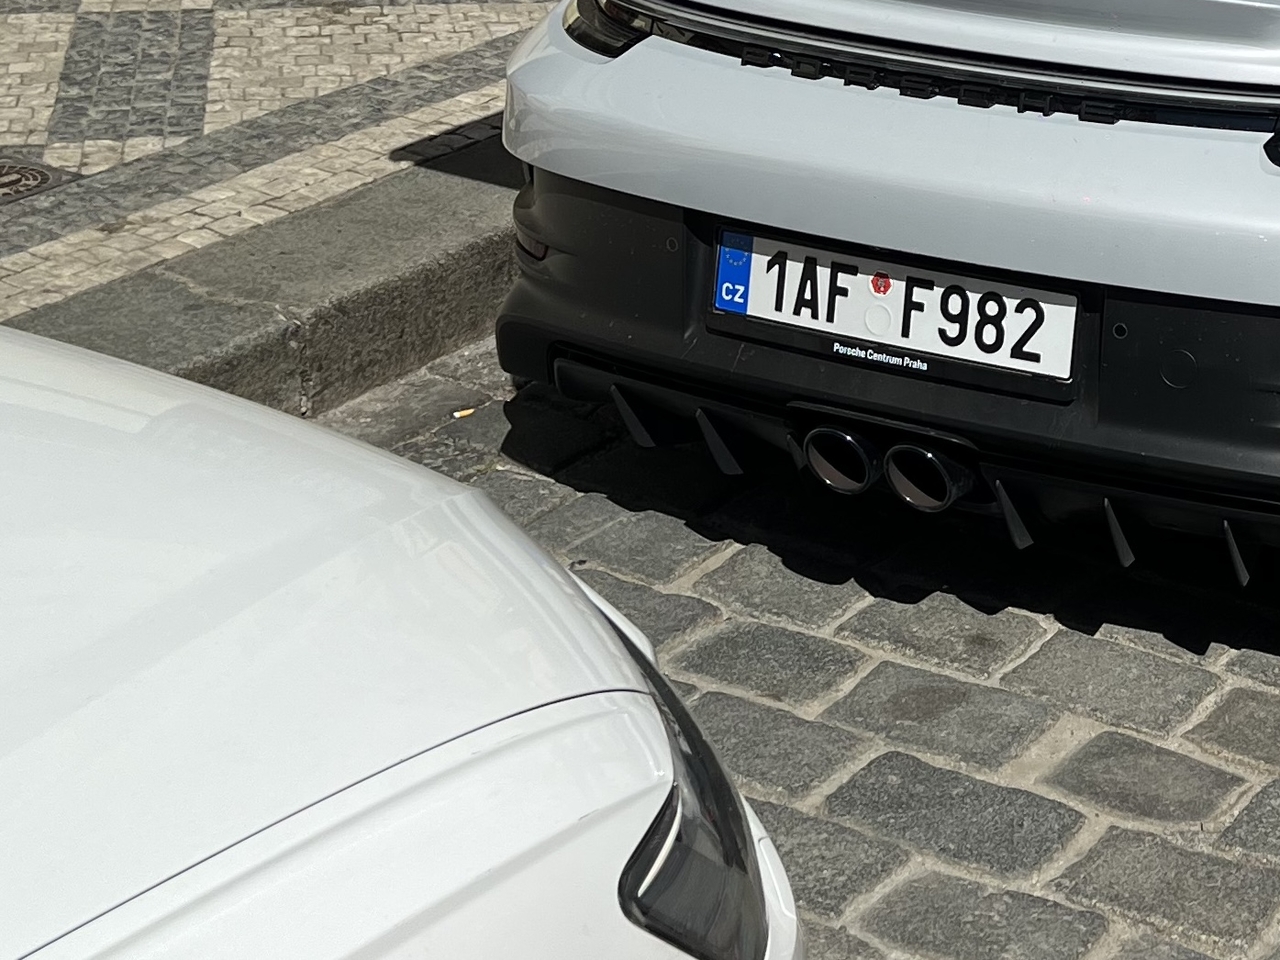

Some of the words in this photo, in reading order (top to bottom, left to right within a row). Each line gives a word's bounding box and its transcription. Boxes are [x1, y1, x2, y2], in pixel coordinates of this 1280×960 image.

[721, 282, 745, 304] CZ
[766, 249, 859, 324] 1AF
[901, 275, 1046, 364] F982
[833, 342, 866, 358] Porsche
[867, 349, 902, 366] Centrum
[903, 356, 928, 371] Praha
